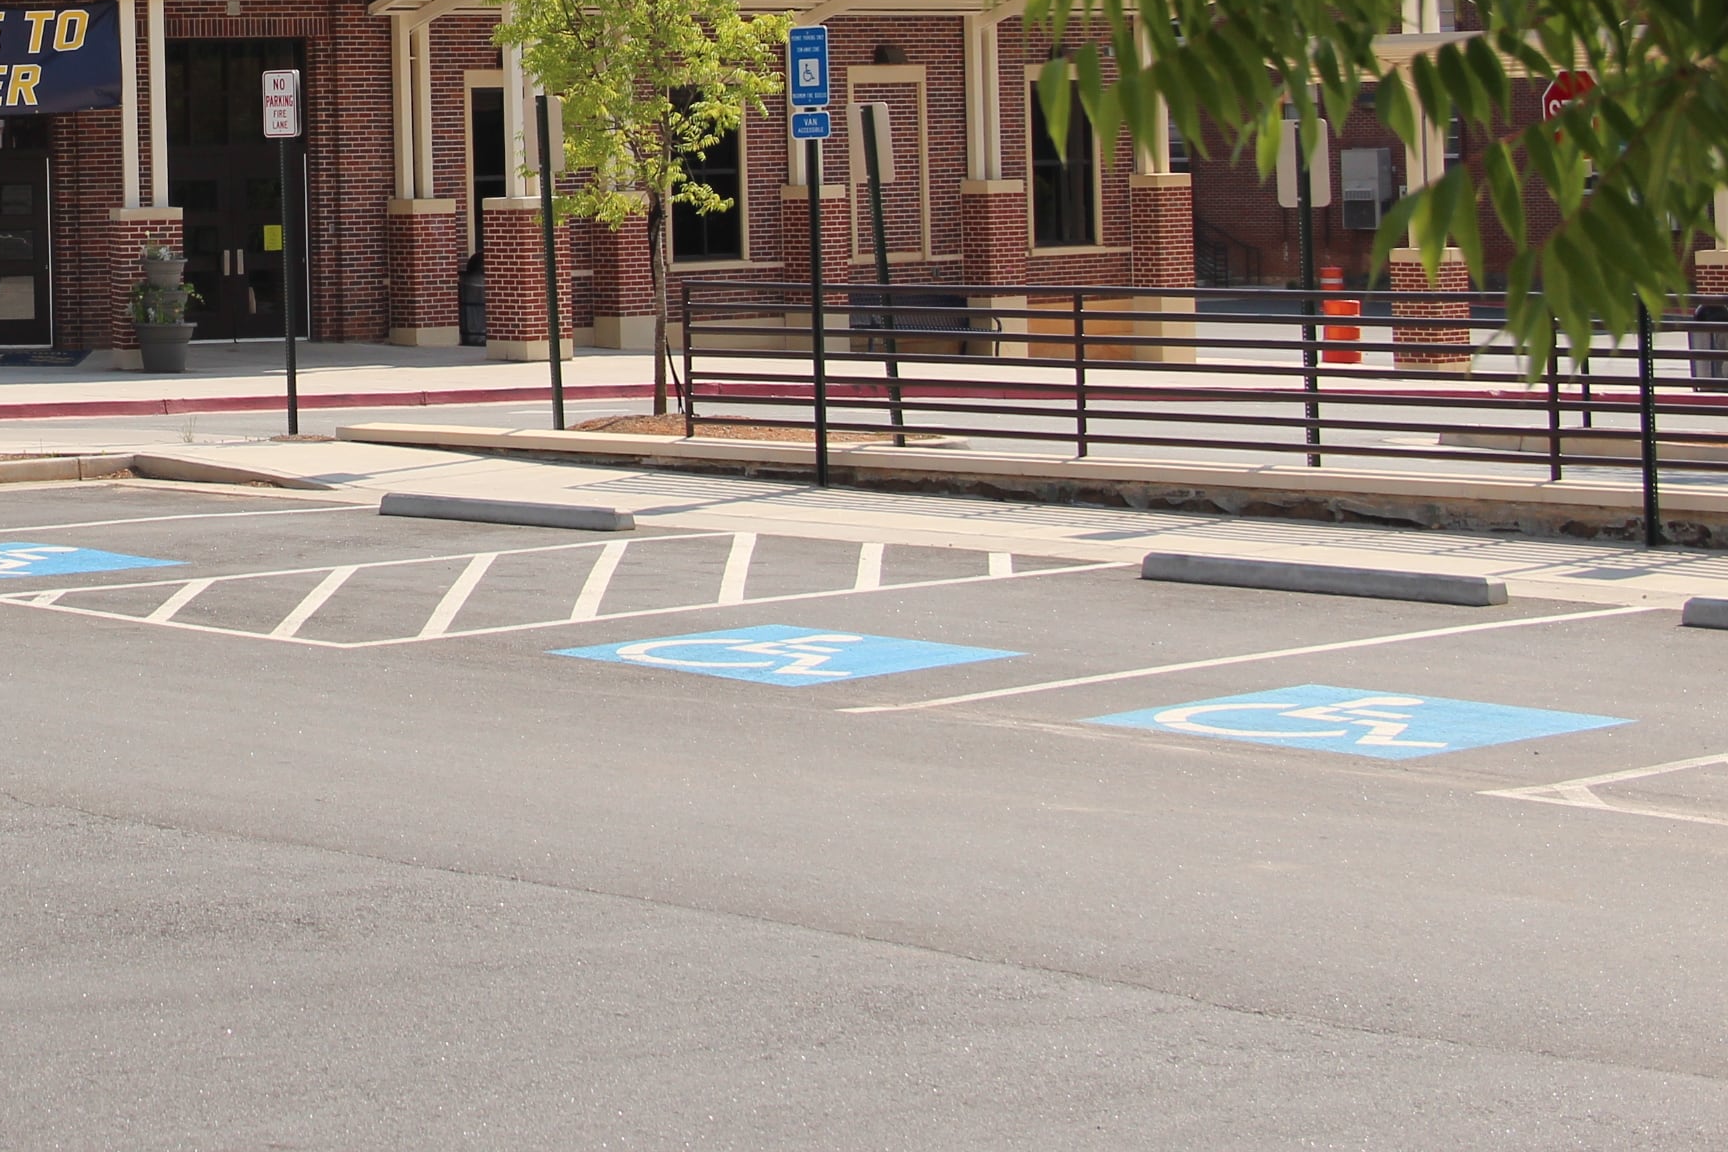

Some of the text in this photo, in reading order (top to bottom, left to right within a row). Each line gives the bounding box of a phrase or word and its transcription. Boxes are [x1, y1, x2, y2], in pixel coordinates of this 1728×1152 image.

[24, 9, 90, 54] TO
[273, 78, 285, 91] NO
[266, 95, 294, 108] PARKING
[273, 109, 287, 118] FIRE
[273, 120, 288, 129] LANE
[803, 118, 818, 126] VAN
